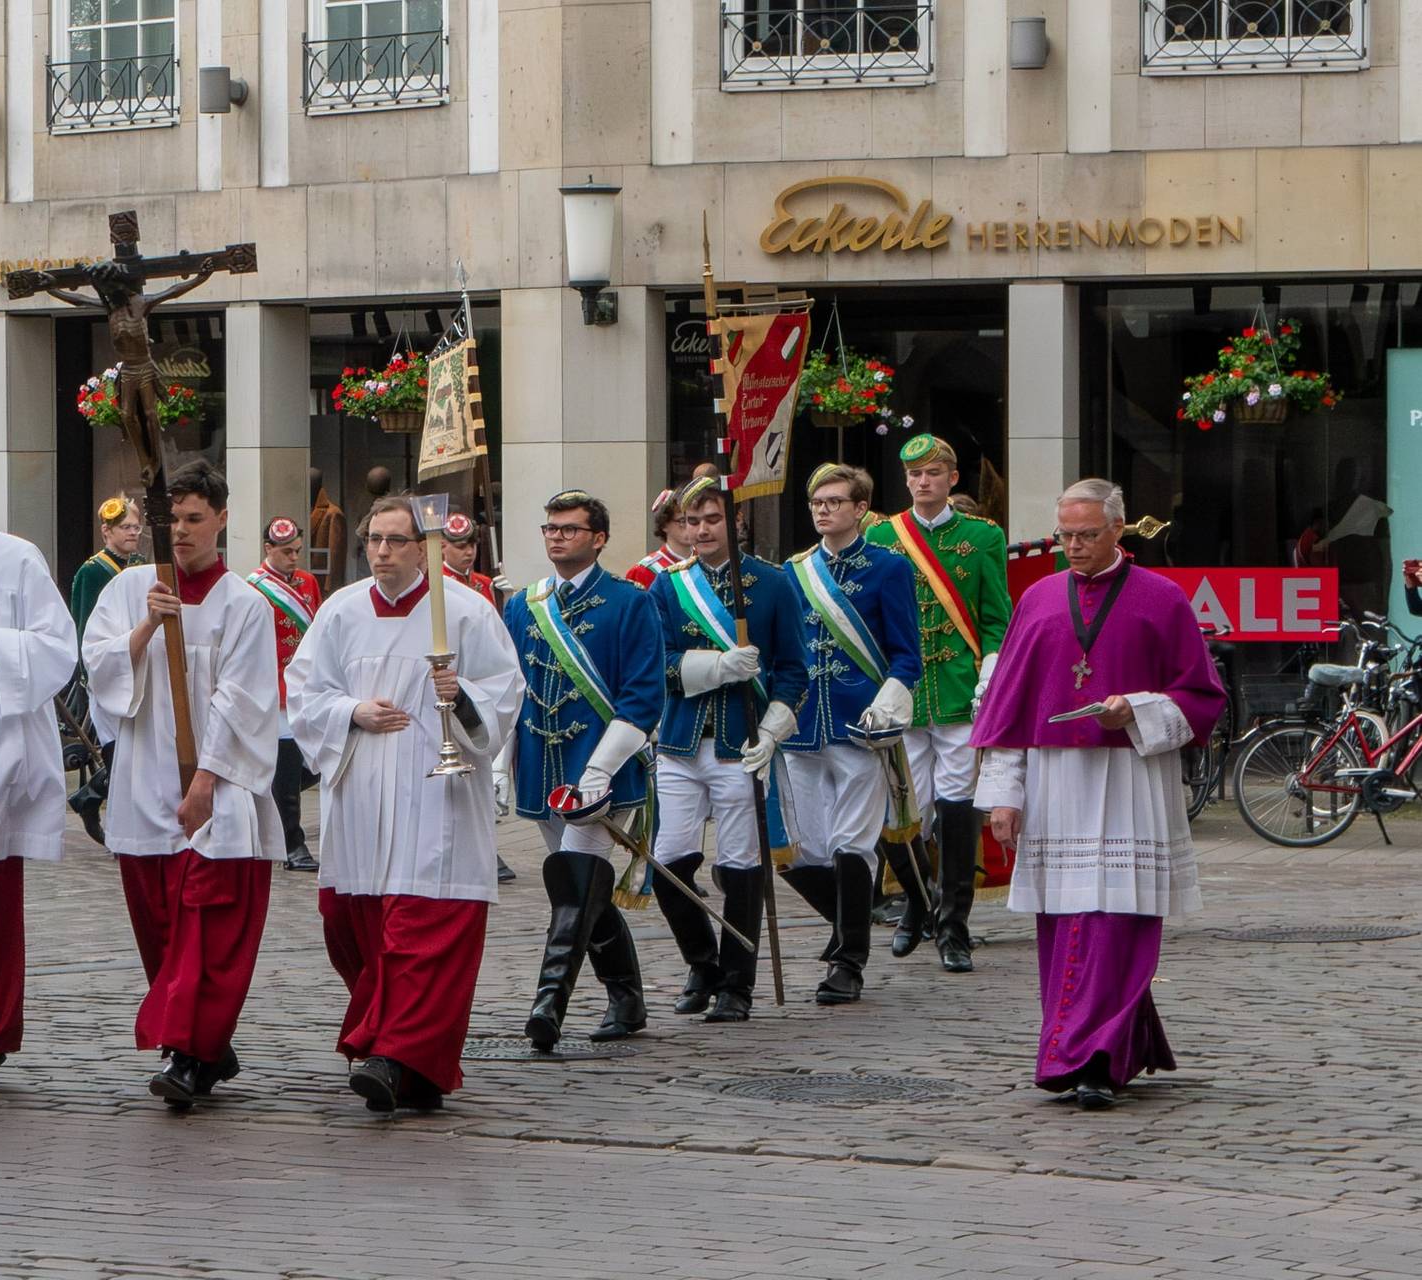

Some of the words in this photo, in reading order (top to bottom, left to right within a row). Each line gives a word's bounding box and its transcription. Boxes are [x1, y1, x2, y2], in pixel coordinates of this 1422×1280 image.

[759, 176, 954, 255] Eckerle
[966, 215, 1243, 251] HERRENMODEN
[1190, 575, 1322, 633] ALE
